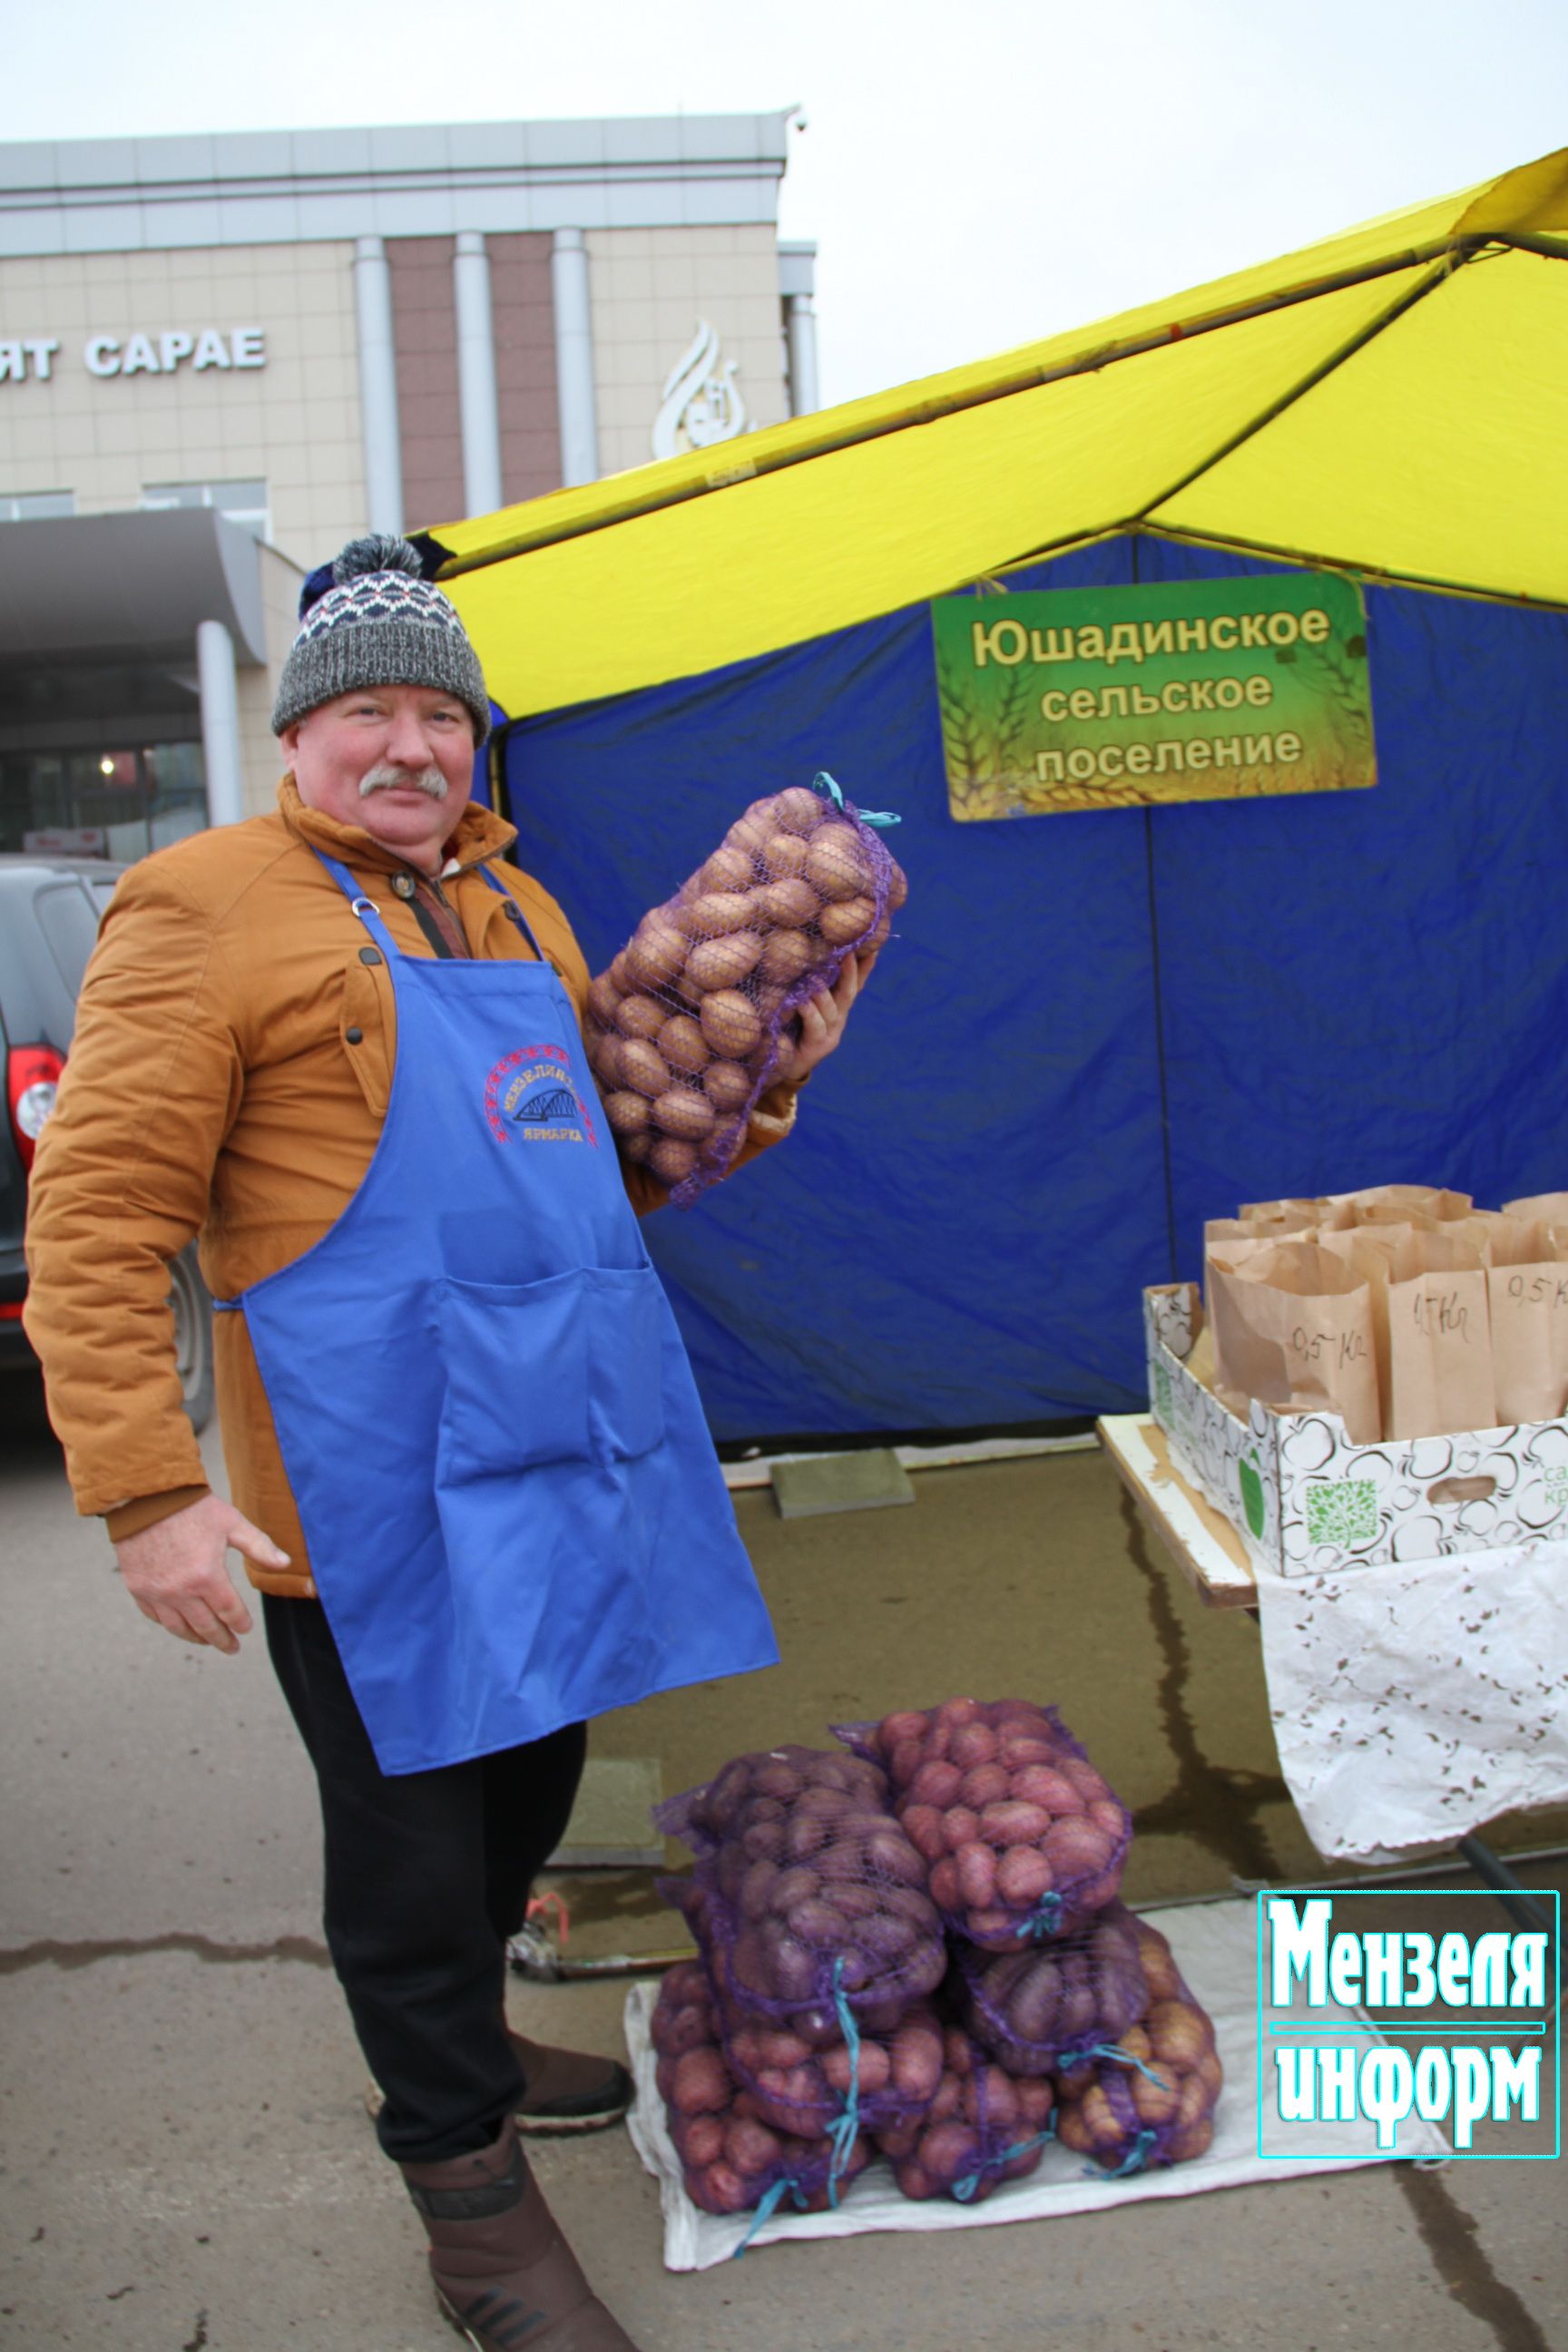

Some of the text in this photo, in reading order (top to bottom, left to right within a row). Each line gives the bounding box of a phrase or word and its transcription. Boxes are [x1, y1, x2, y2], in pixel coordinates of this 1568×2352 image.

[84, 327, 267, 377] САРАЕ
[971, 608, 1330, 669] Юшадинское
[1040, 674, 1273, 722] сельское
[1034, 730, 1303, 782] поселение
